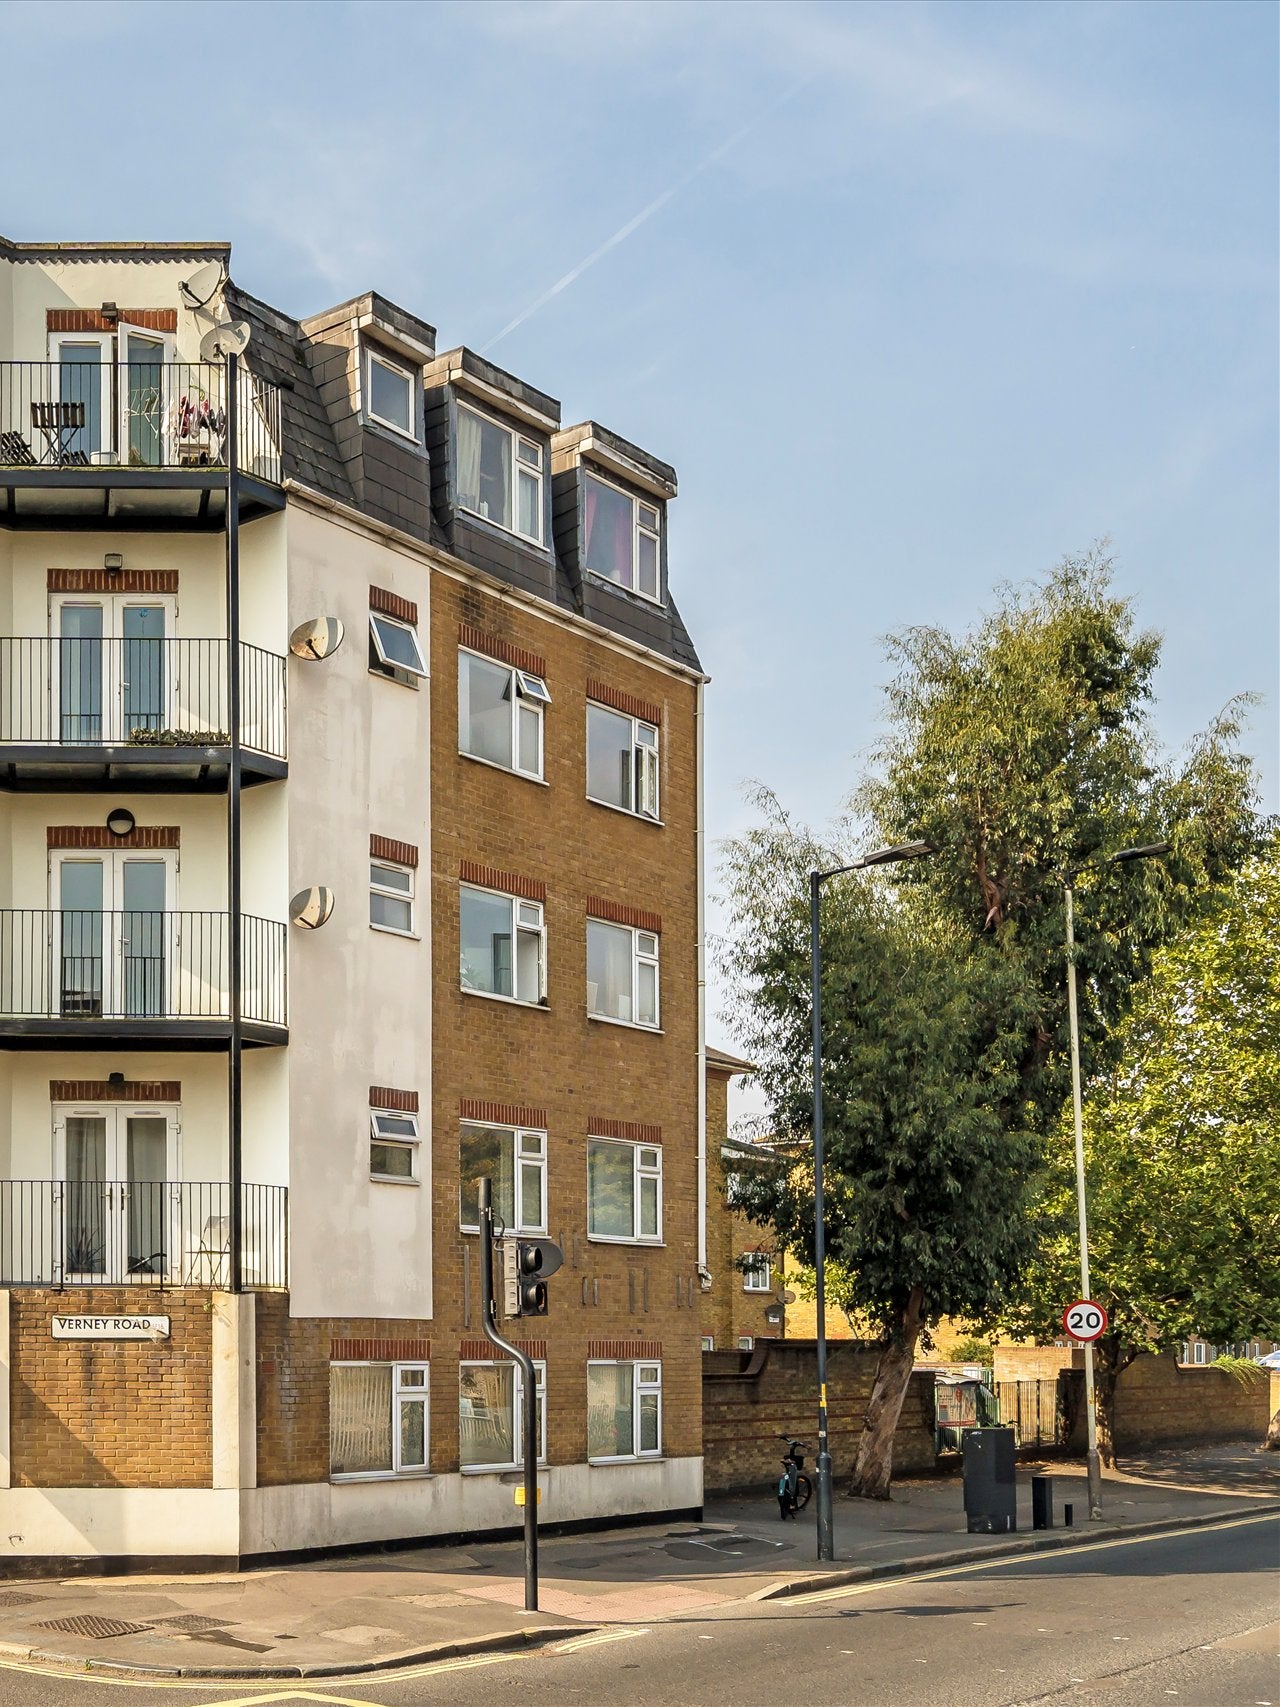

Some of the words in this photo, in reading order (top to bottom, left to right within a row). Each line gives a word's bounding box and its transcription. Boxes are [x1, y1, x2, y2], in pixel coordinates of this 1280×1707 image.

[59, 1319, 108, 1329] VERNEY
[113, 1319, 150, 1329] ROAD
[1070, 1312, 1100, 1328] 20
